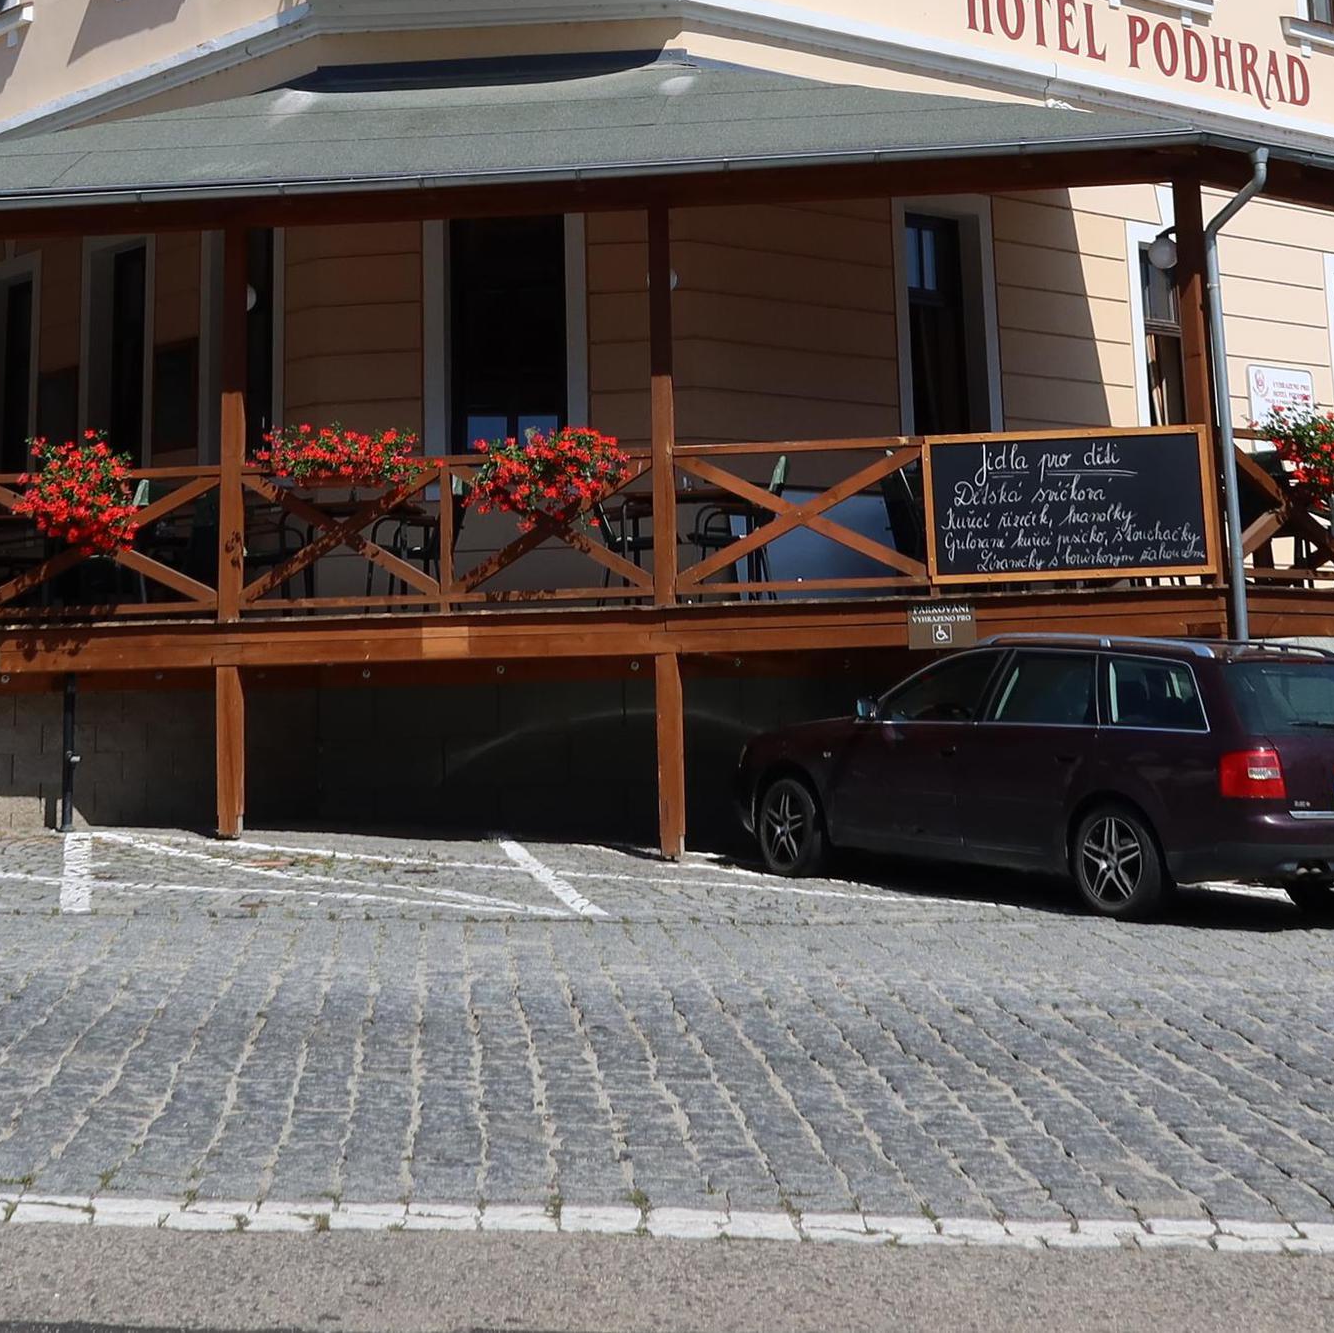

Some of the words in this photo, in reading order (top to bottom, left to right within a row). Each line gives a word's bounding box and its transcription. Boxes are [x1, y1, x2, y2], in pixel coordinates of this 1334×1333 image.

[1126, 13, 1311, 110] PODHRAD
[1038, 453, 1072, 483] pro
[1083, 442, 1120, 466] děti
[957, 614, 971, 622] PRO
